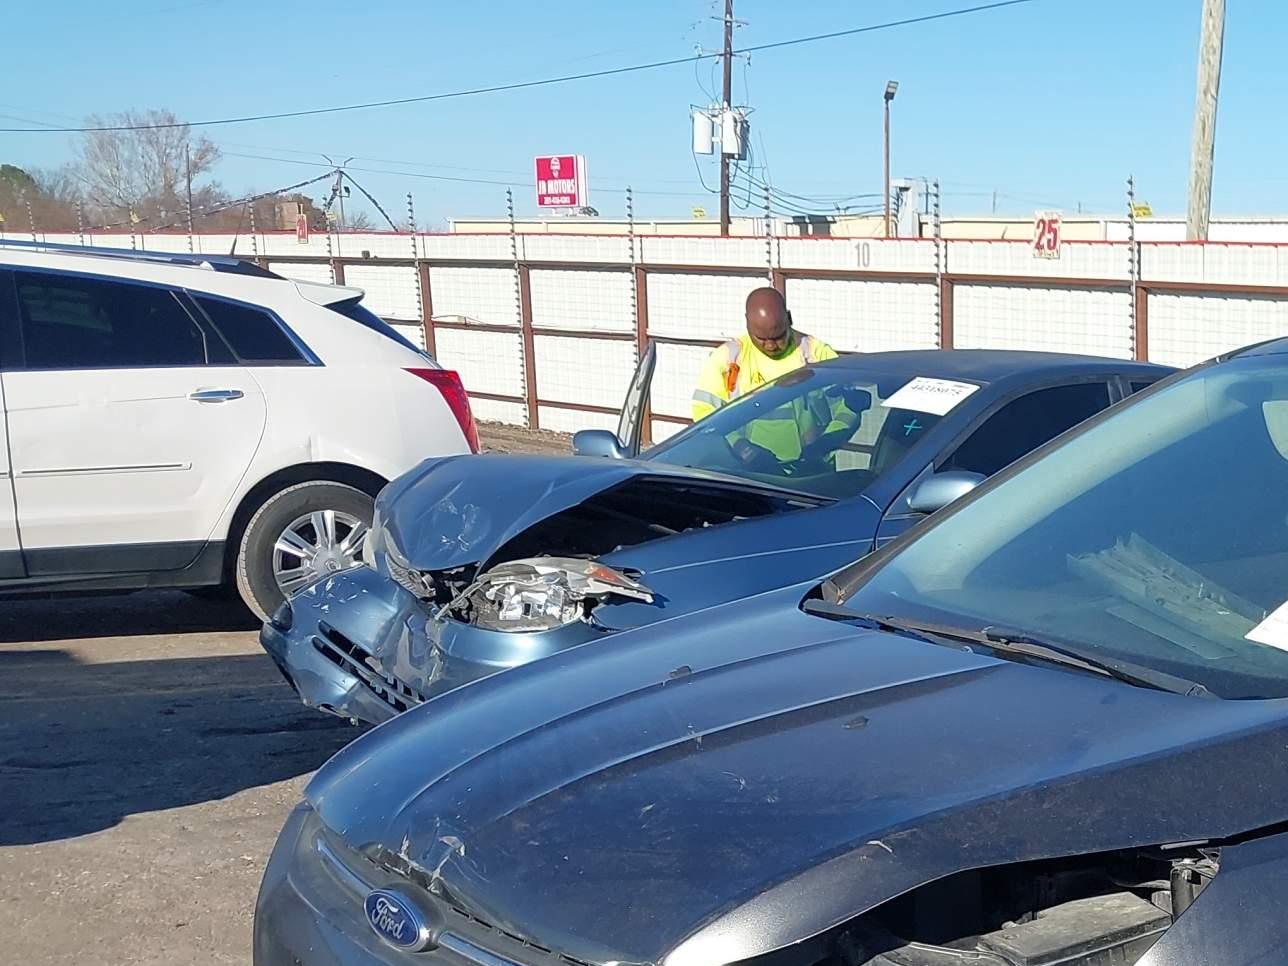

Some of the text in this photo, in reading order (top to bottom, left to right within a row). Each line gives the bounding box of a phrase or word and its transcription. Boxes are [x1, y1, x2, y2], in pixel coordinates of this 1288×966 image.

[547, 178, 576, 195] MOTORS
[1034, 218, 1058, 251] 25
[854, 242, 870, 268] 10
[371, 897, 405, 940] Ford
